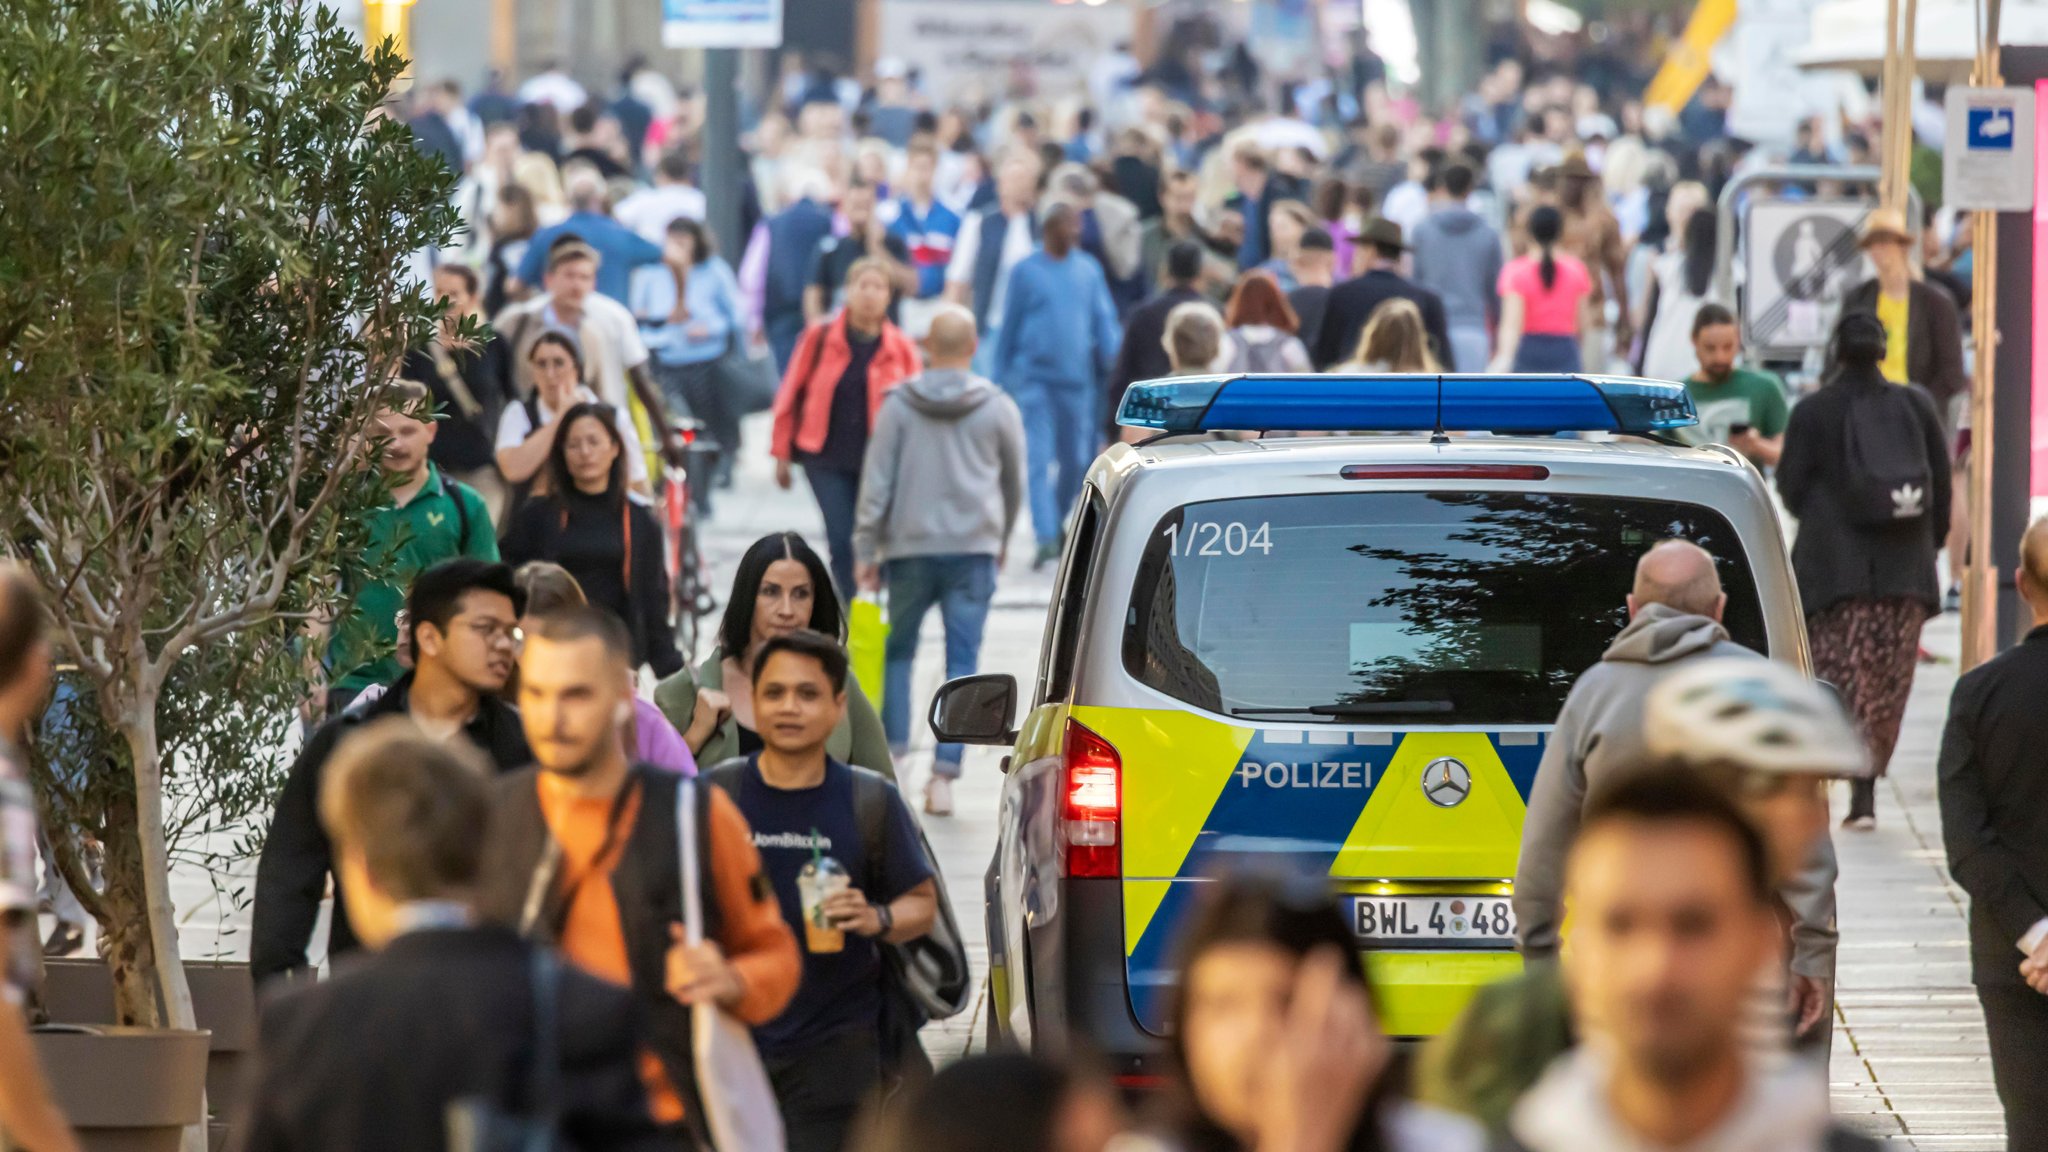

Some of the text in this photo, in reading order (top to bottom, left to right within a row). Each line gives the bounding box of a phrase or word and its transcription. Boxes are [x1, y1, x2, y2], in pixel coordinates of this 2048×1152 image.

[1163, 521, 1273, 557] 1/204
[1242, 762, 1372, 788] POLIZEI
[1357, 902, 1418, 934] BWL
[1471, 902, 1518, 935] 48
